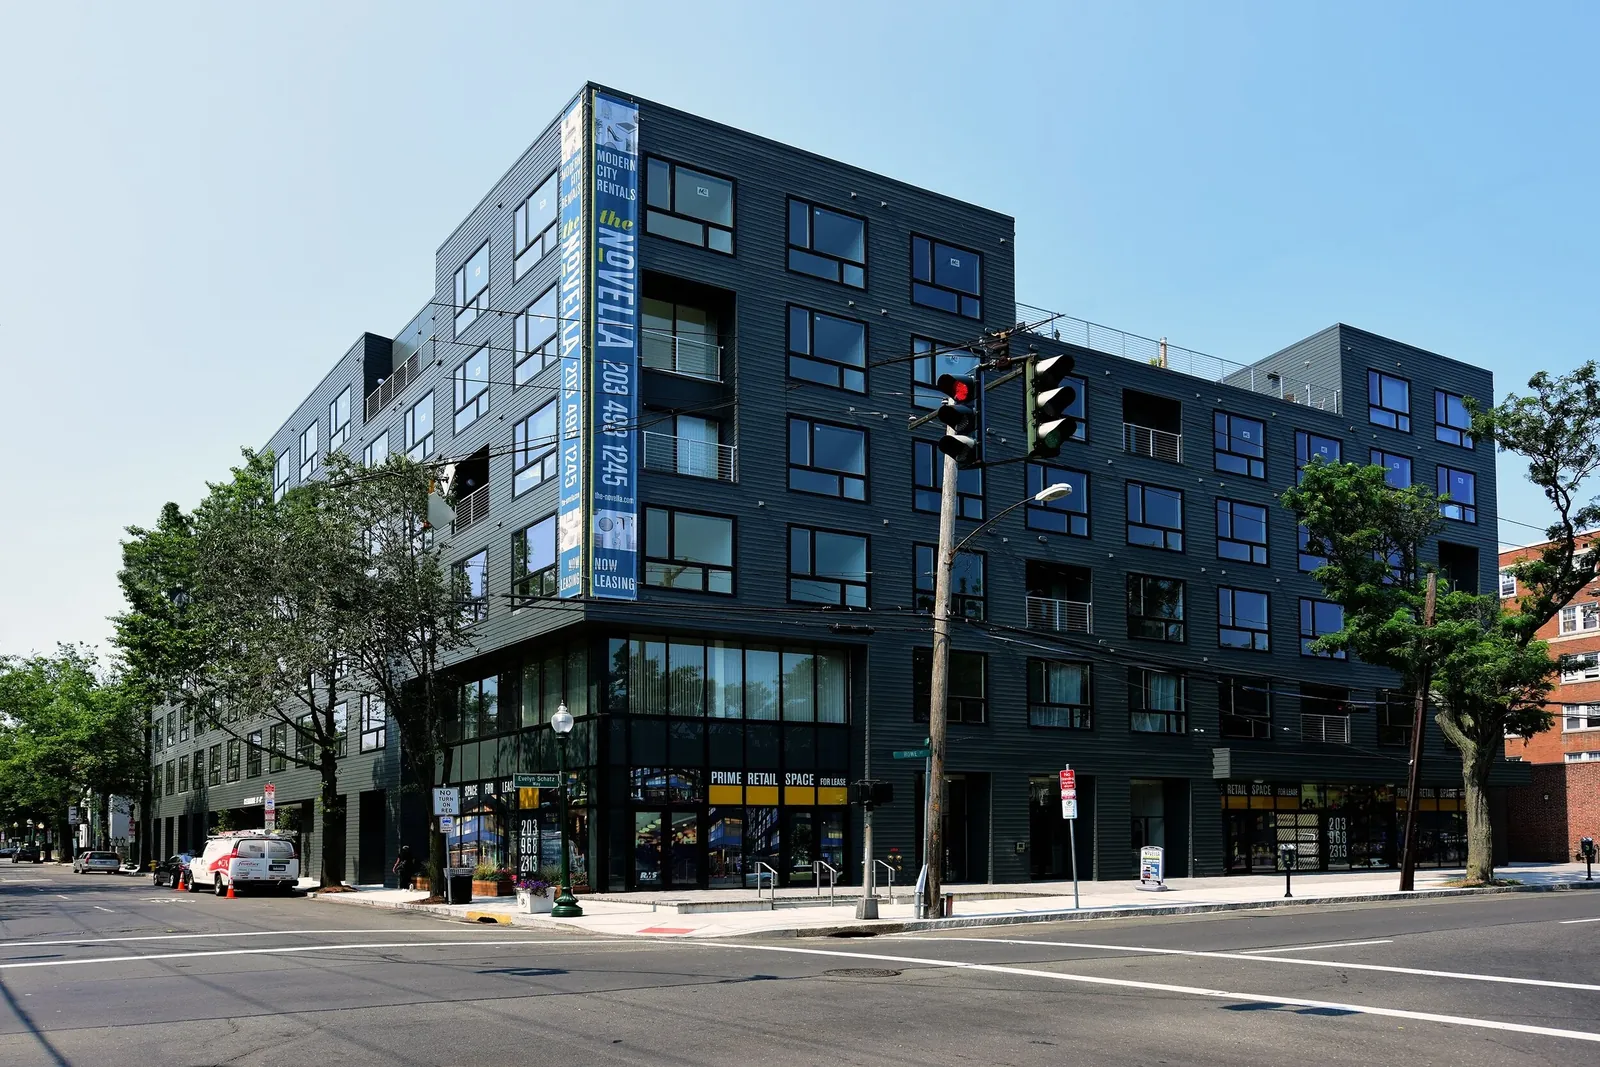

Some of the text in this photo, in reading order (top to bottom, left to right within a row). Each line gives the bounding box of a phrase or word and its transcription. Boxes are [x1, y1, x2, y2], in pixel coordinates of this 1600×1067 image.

[597, 150, 636, 171] MODERN
[597, 163, 618, 180] CITY
[597, 179, 636, 201] RENTALS
[563, 215, 580, 240] the
[599, 210, 634, 230] the
[562, 229, 580, 356] NOVELLA
[598, 227, 634, 348] NOVELLA
[602, 359, 629, 488] 203 498 1245
[565, 443, 578, 489] 1245
[595, 557, 617, 572] NOW
[561, 574, 580, 590] LEASING
[595, 574, 635, 591] LEASING
[518, 775, 536, 783] Evelyn
[711, 771, 846, 786] PRIME RETAIL SPACE FOR LEASE
[485, 783, 494, 795] FOR
[1227, 784, 1248, 795] RETAIL
[1251, 784, 1271, 796] SPACE
[1277, 787, 1286, 795] FOR
[1287, 788, 1298, 796] LEASE
[1419, 787, 1435, 798] RETAIL
[521, 819, 538, 837] 203
[1329, 817, 1347, 830] 203
[521, 837, 538, 854] 968
[1329, 831, 1347, 844] 968
[1329, 845, 1347, 858] 2313
[520, 855, 538, 872] 2313
